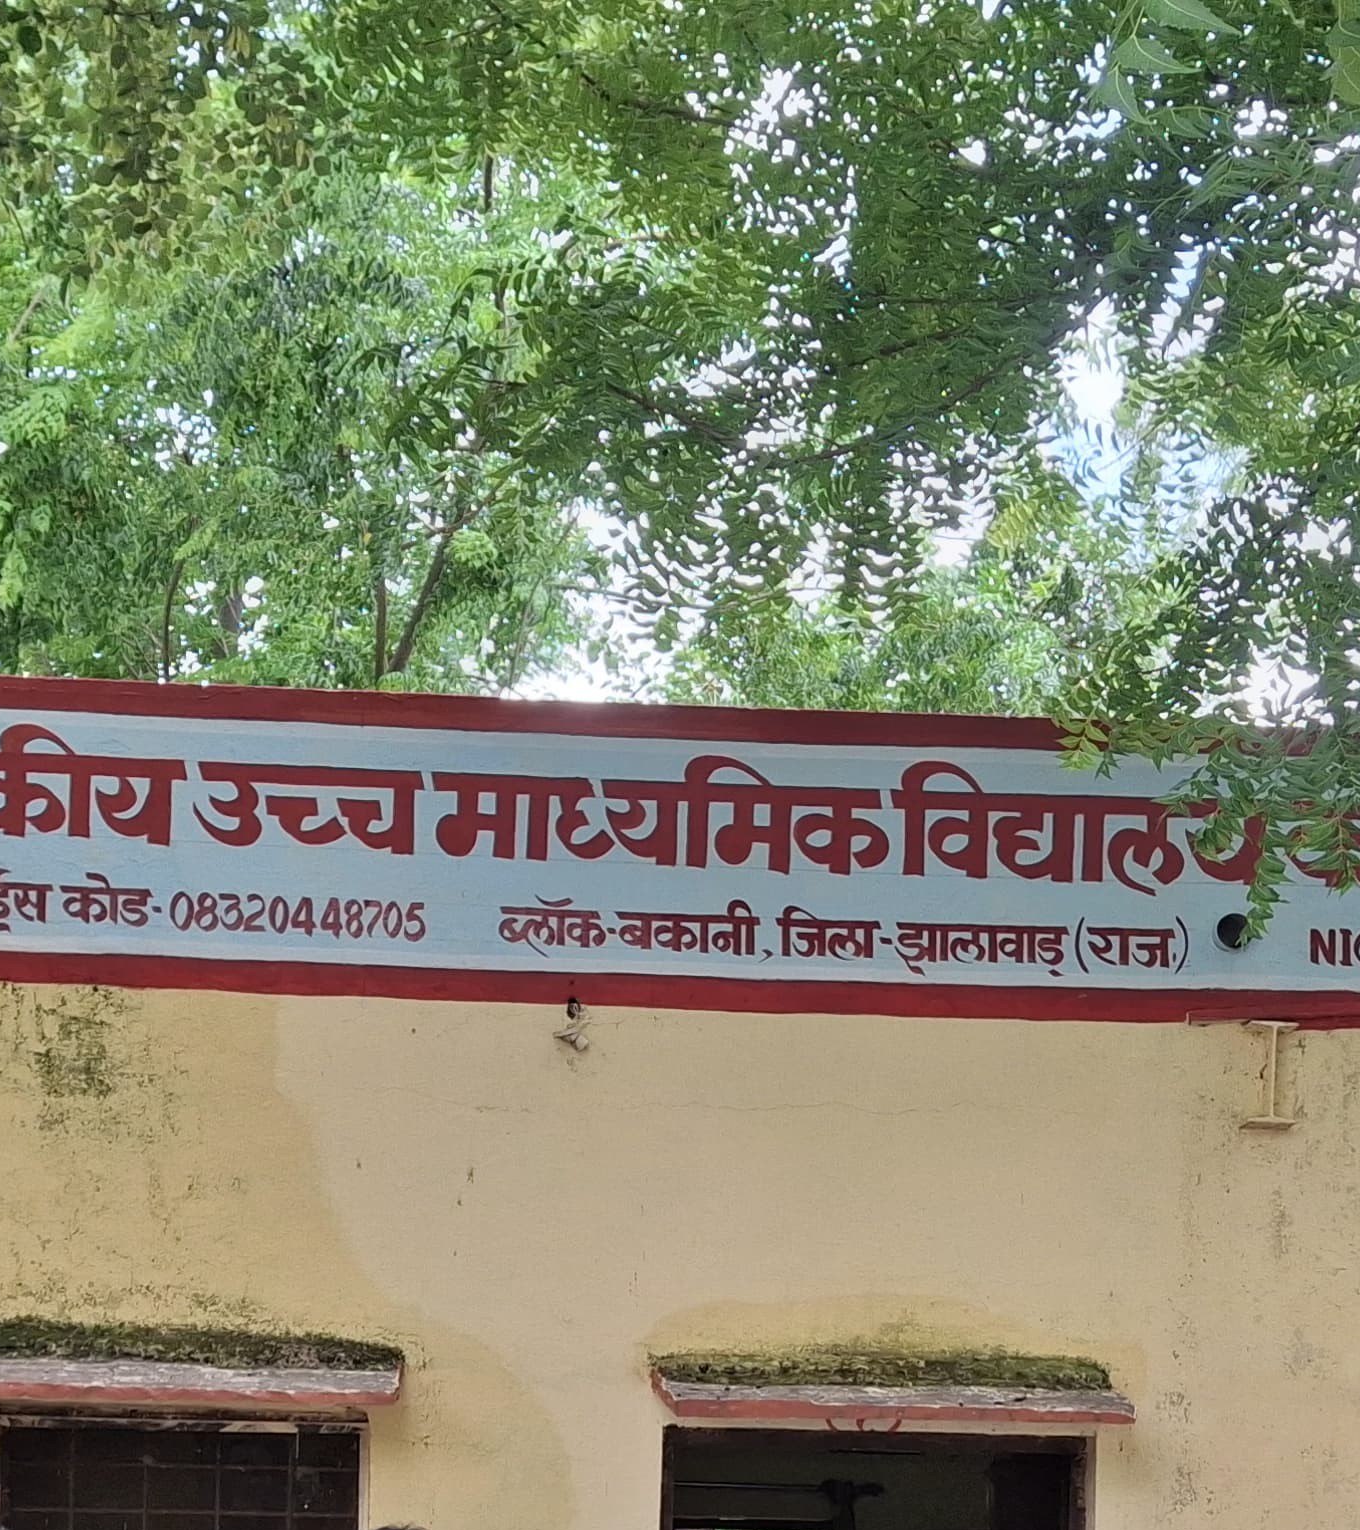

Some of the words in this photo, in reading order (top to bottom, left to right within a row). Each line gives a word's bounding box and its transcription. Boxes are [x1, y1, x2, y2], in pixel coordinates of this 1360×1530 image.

[193, 760, 424, 856] उच्च
[433, 754, 884, 877] माध्यमिक
[170, 890, 426, 943] 08320448705
